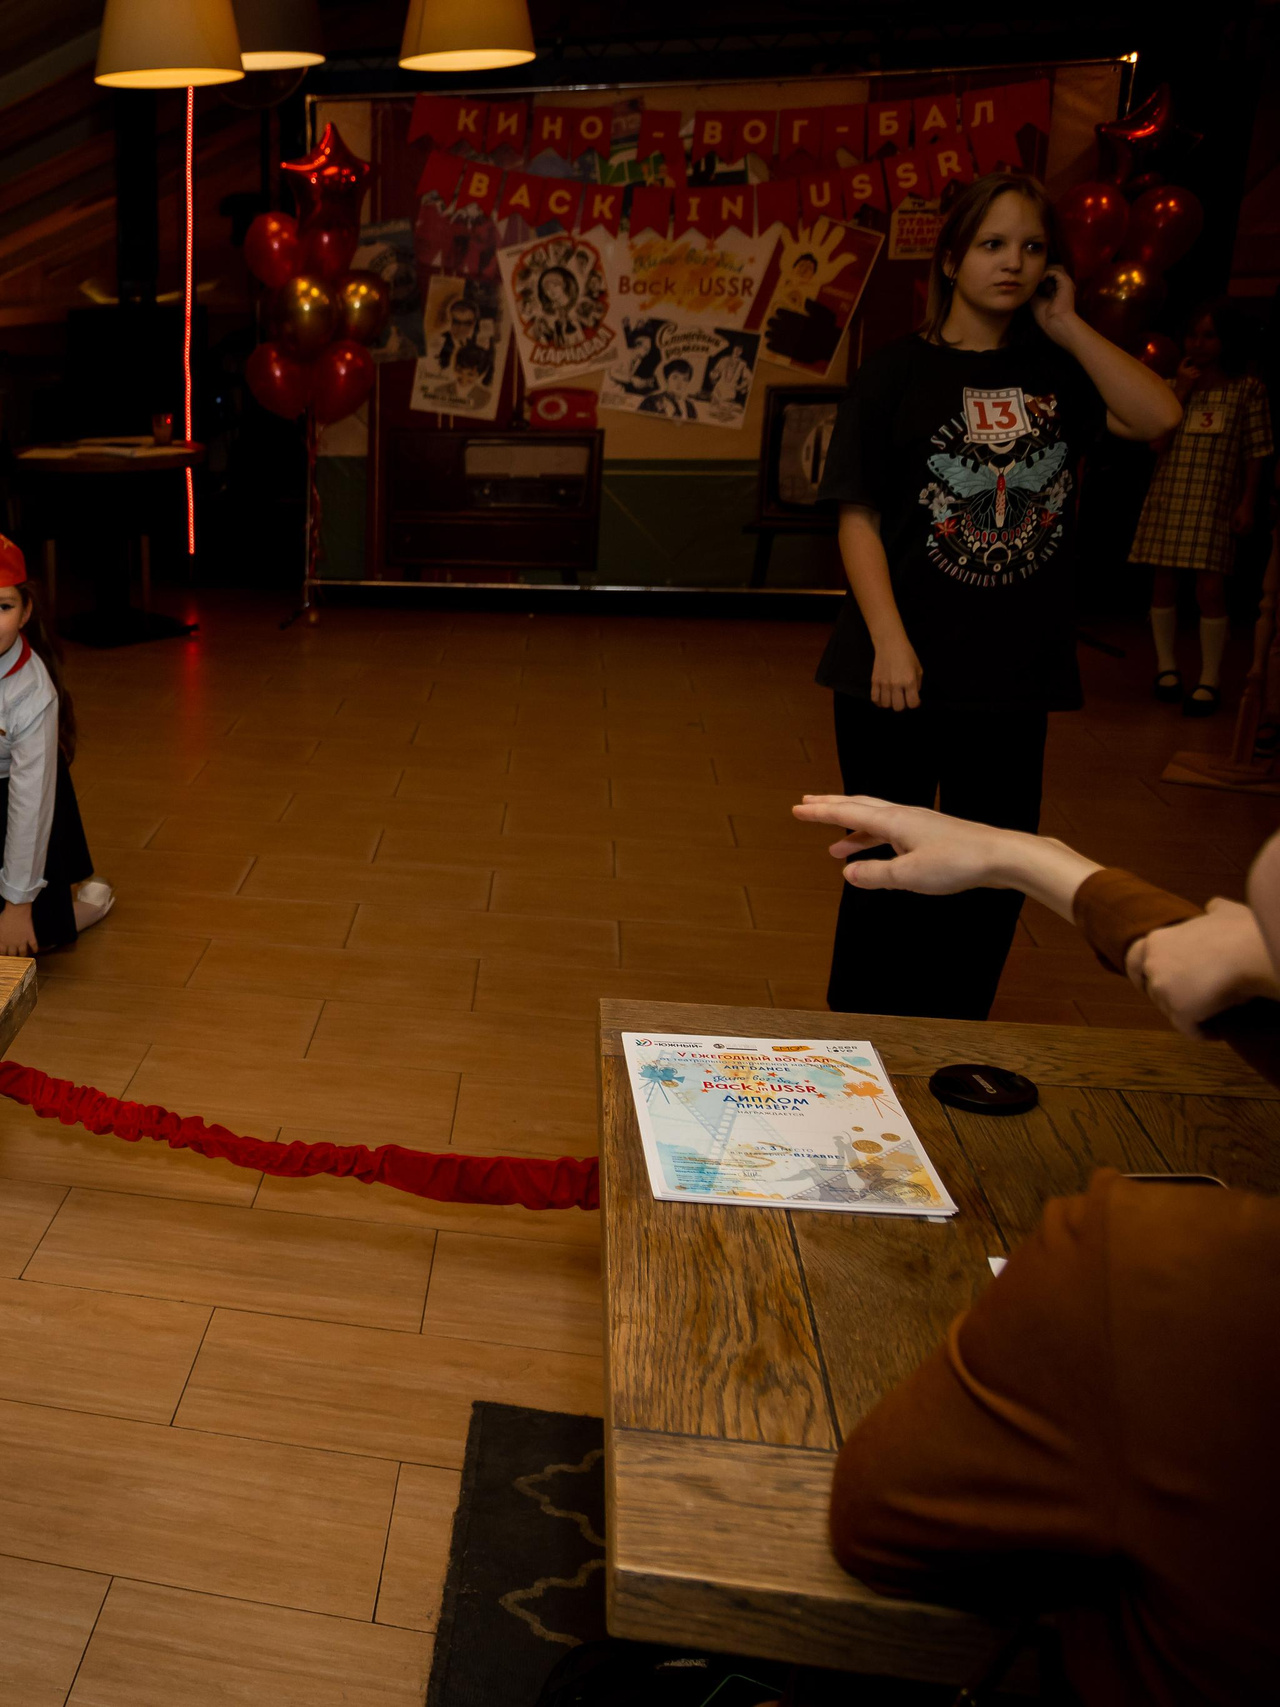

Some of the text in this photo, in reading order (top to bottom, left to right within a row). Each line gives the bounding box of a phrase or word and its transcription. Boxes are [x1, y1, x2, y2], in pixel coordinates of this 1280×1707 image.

[468, 149, 963, 222] BACK IN USSR
[618, 275, 676, 296] Back
[698, 276, 755, 298] USSR
[972, 401, 1018, 430] 13
[1200, 413, 1214, 428] 3
[691, 1053, 771, 1062] ЕЖЕГОДНЫЙ
[702, 1081, 753, 1091] Back
[770, 1084, 818, 1094] USSR
[723, 1095, 809, 1105] ДИПЛОМ
[736, 1102, 801, 1112] ПРИЗЁРА
